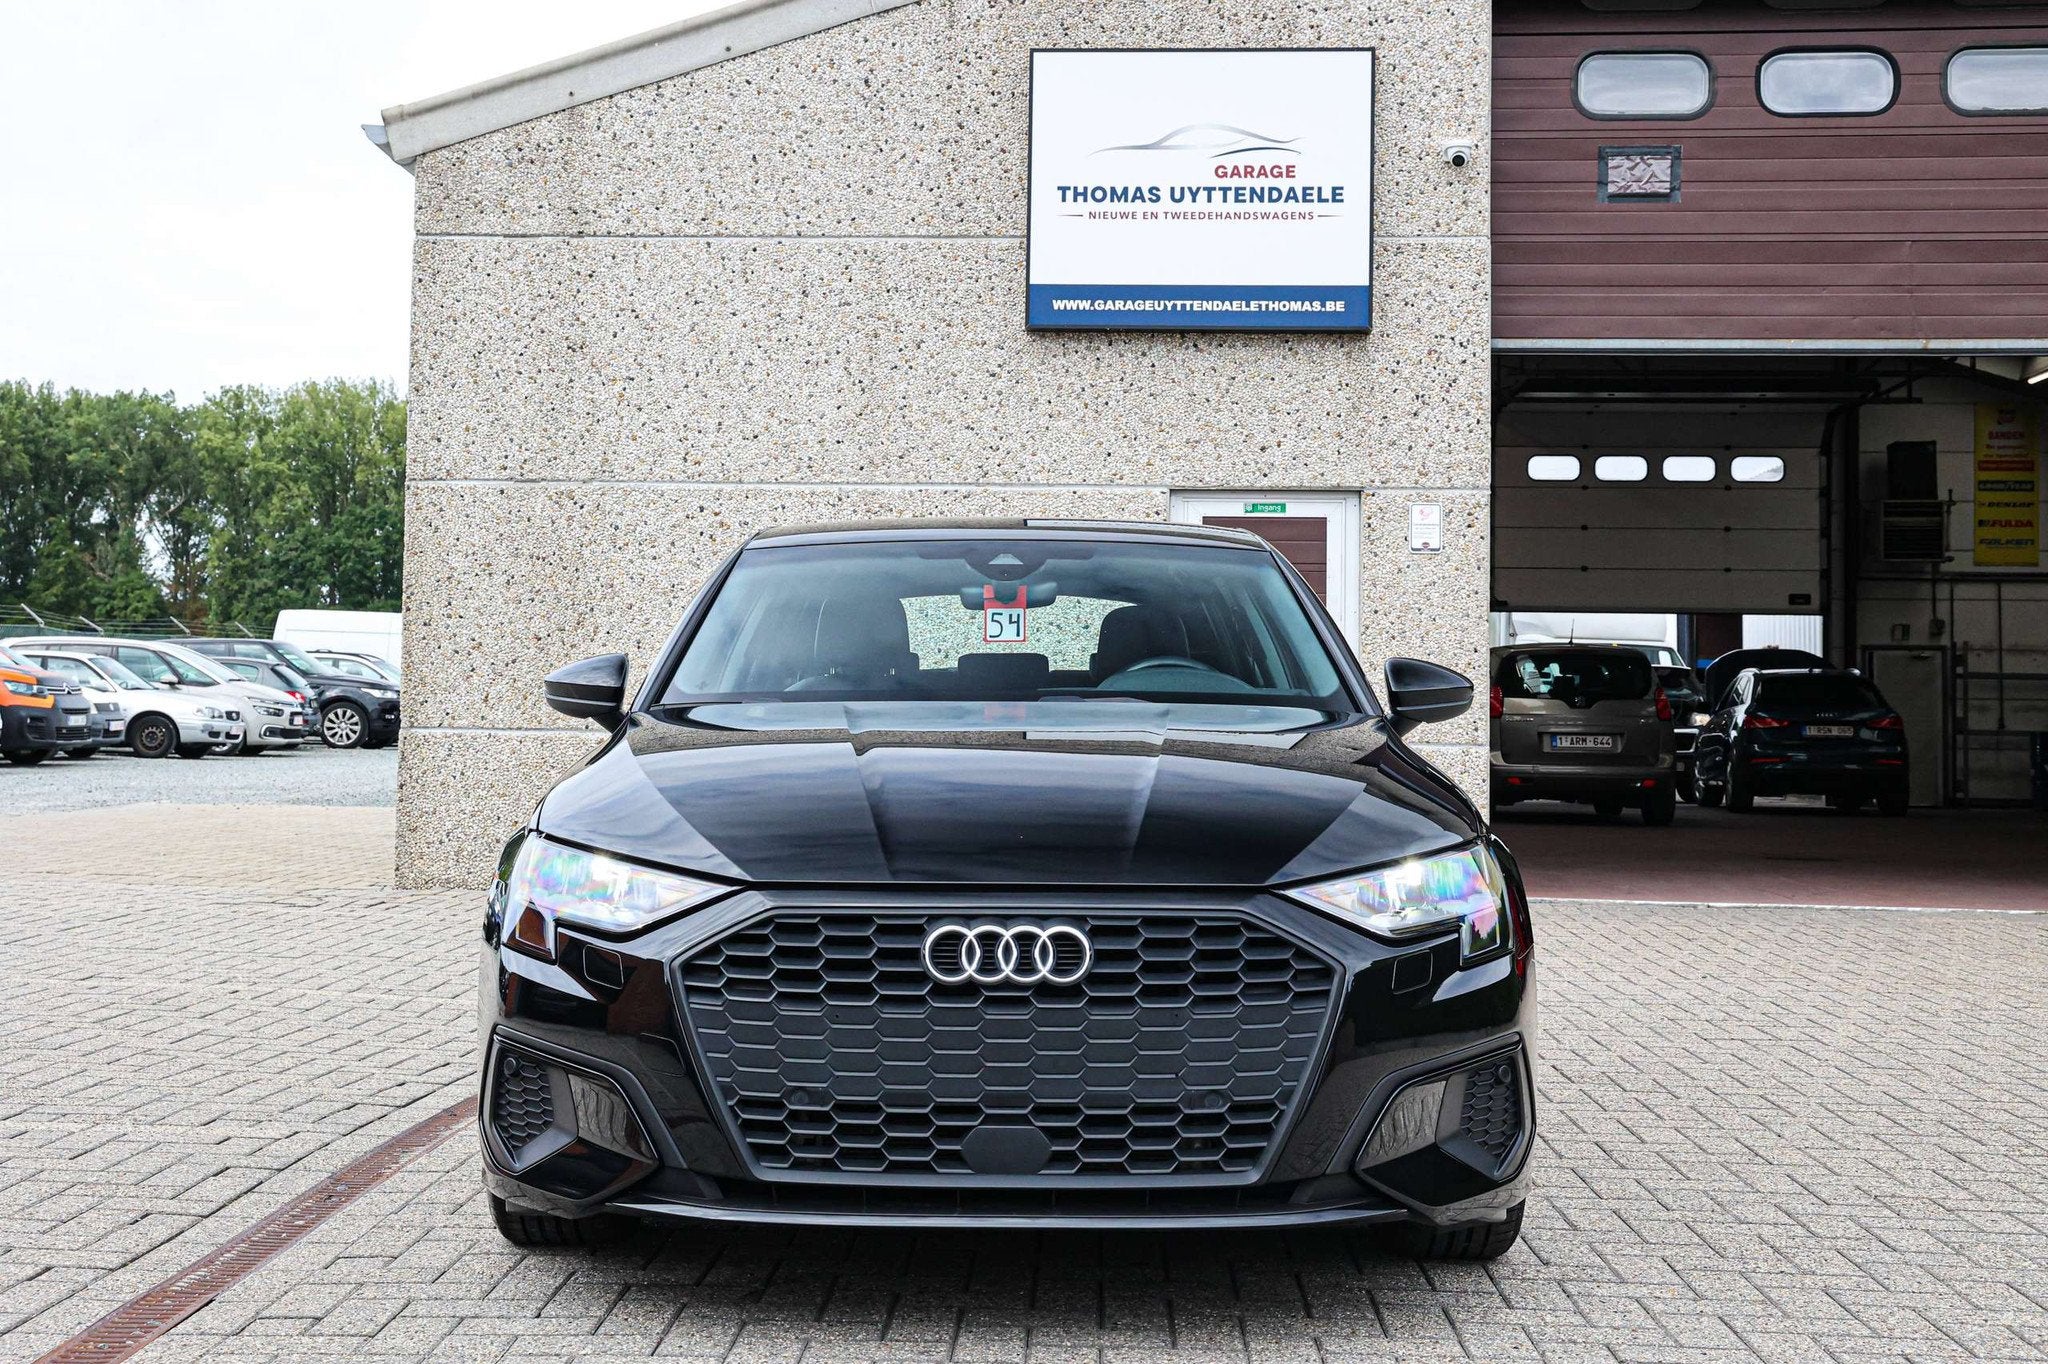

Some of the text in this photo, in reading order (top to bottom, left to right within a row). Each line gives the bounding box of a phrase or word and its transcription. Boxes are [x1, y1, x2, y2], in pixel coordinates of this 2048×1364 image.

[1214, 164, 1297, 179] GARAGE
[1056, 185, 1345, 204] THOMAS UYTTENDAELE
[1088, 210, 1314, 221] NIEUWE EN TWEEDEHANDSWAGENS
[1052, 299, 1346, 312] WWW.GARAGEUYTTENDAELETHOMAS.BE
[1257, 504, 1281, 513] Ingang
[1990, 519, 2034, 528] FULDA
[988, 612, 1021, 639] 54
